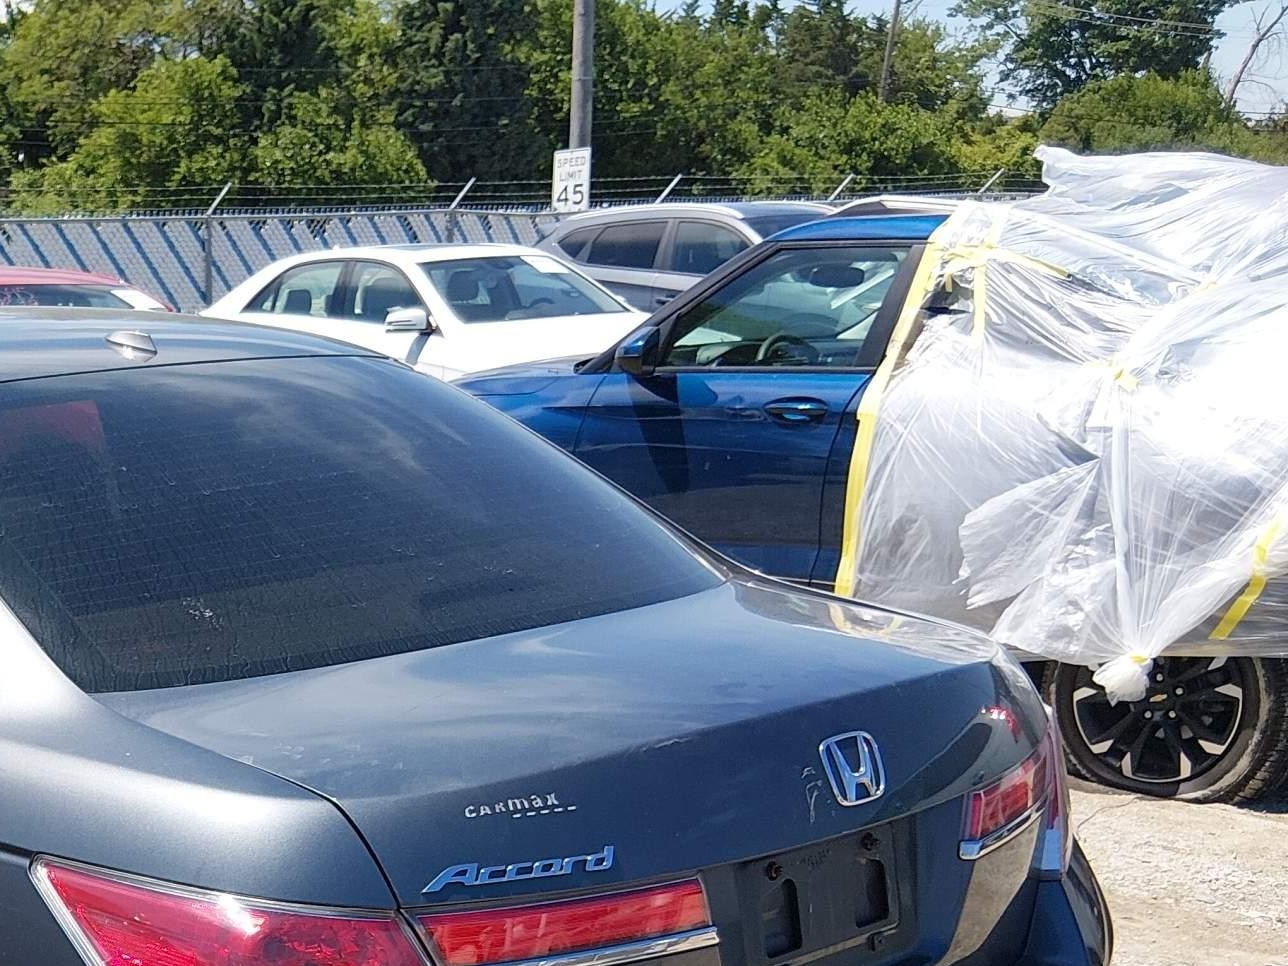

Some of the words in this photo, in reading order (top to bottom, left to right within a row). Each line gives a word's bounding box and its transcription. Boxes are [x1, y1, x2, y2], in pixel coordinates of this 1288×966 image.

[557, 156, 586, 168] SPEED
[559, 170, 583, 182] LIMIT
[556, 183, 584, 206] 45
[421, 845, 615, 894] Accord
